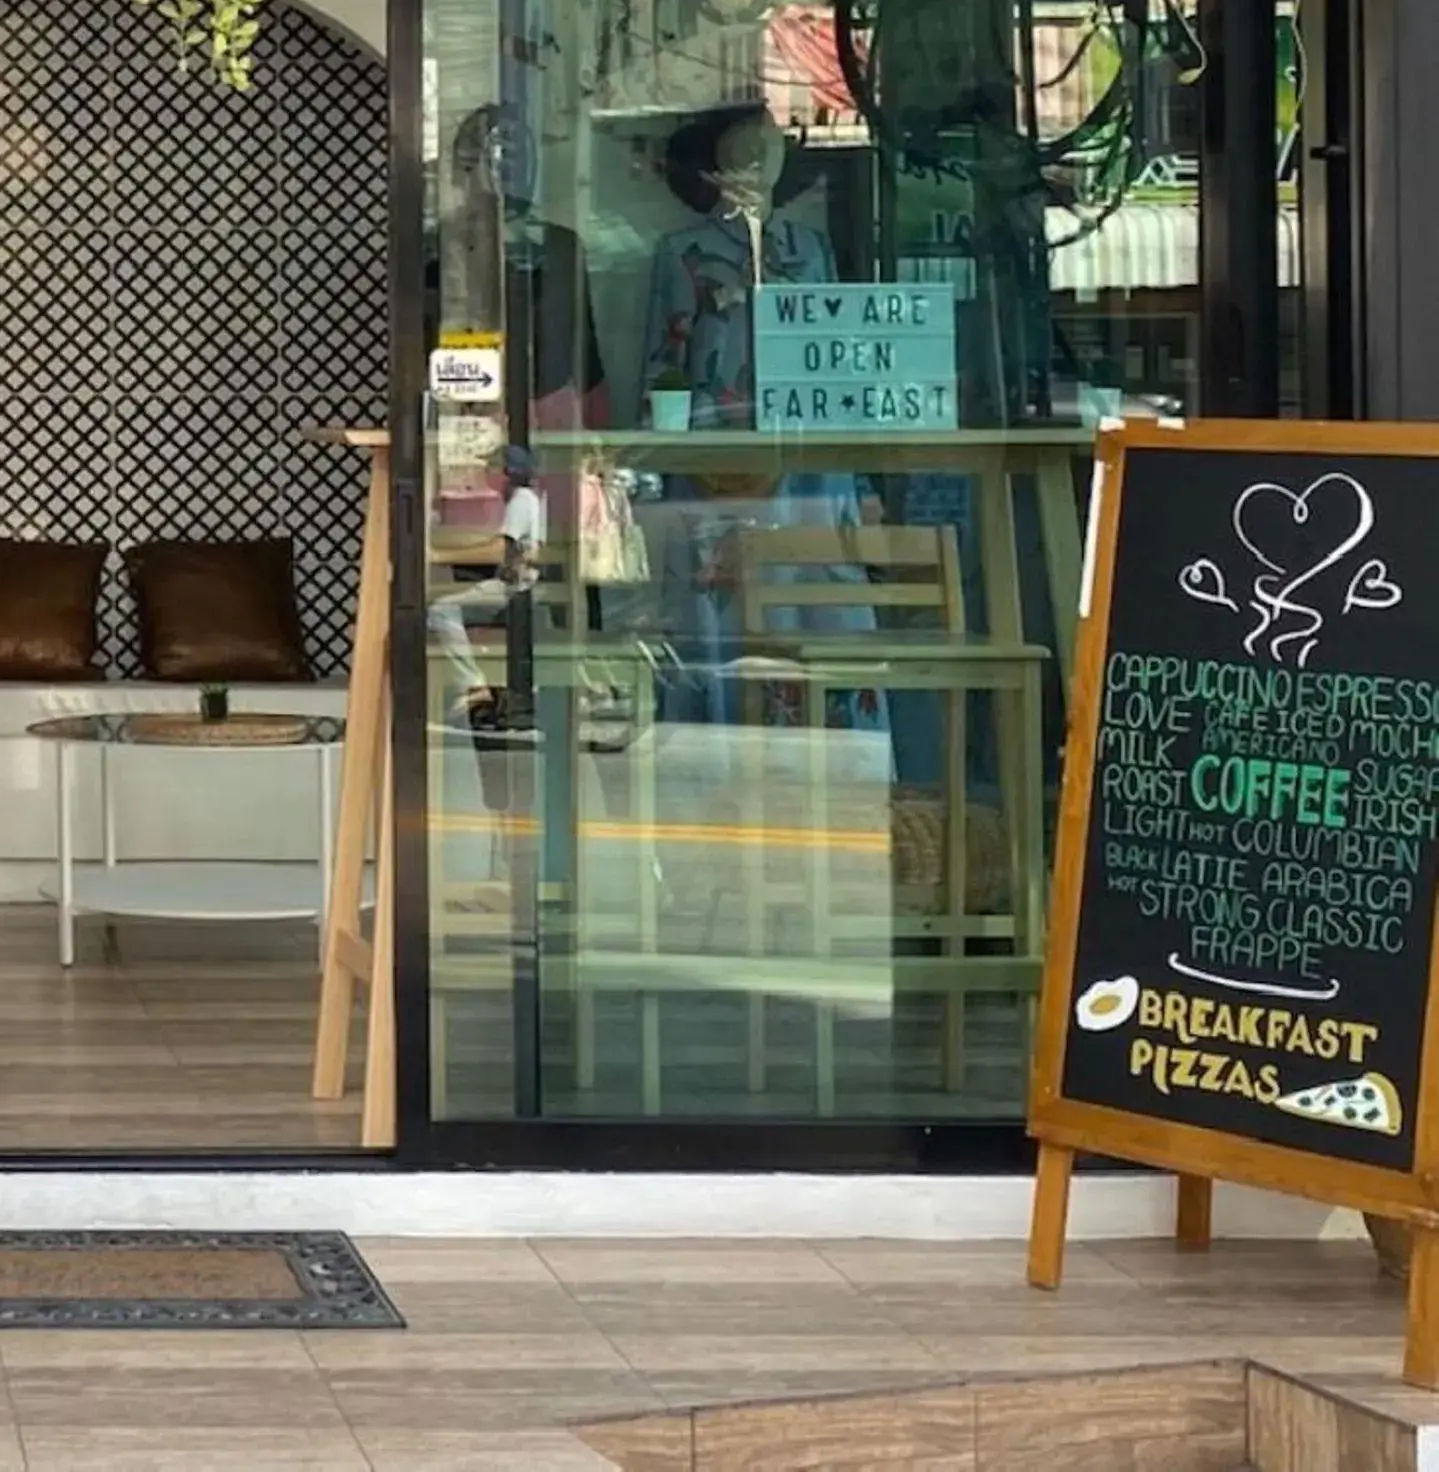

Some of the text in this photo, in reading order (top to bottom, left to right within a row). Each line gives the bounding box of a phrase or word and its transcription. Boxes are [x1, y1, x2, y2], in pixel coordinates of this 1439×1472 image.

[775, 294, 928, 325] WE ARE
[804, 341, 893, 371] OPEN
[763, 387, 947, 419] FAR EAST
[1107, 652, 1293, 709] CAPPUCCINO
[1105, 690, 1192, 732] LOVE
[1204, 699, 1269, 732] CAFE
[1277, 707, 1346, 739] ICED
[1099, 726, 1340, 768] MILK AMERICANO
[1102, 763, 1187, 806] ROAST
[1191, 754, 1351, 827] COFFEE
[1352, 794, 1438, 841] IRISH
[1103, 801, 1420, 874] LIGHT HOT COLUMBIAN
[1105, 841, 1158, 871] BLACK
[1262, 861, 1413, 912] ARABICA
[1139, 879, 1260, 930] STRONG
[1266, 898, 1404, 954] CLASSIC
[1191, 925, 1323, 979] FRAPPE
[1138, 988, 1379, 1063] BREAKFAST
[1130, 1038, 1281, 1104] PIZZAS
